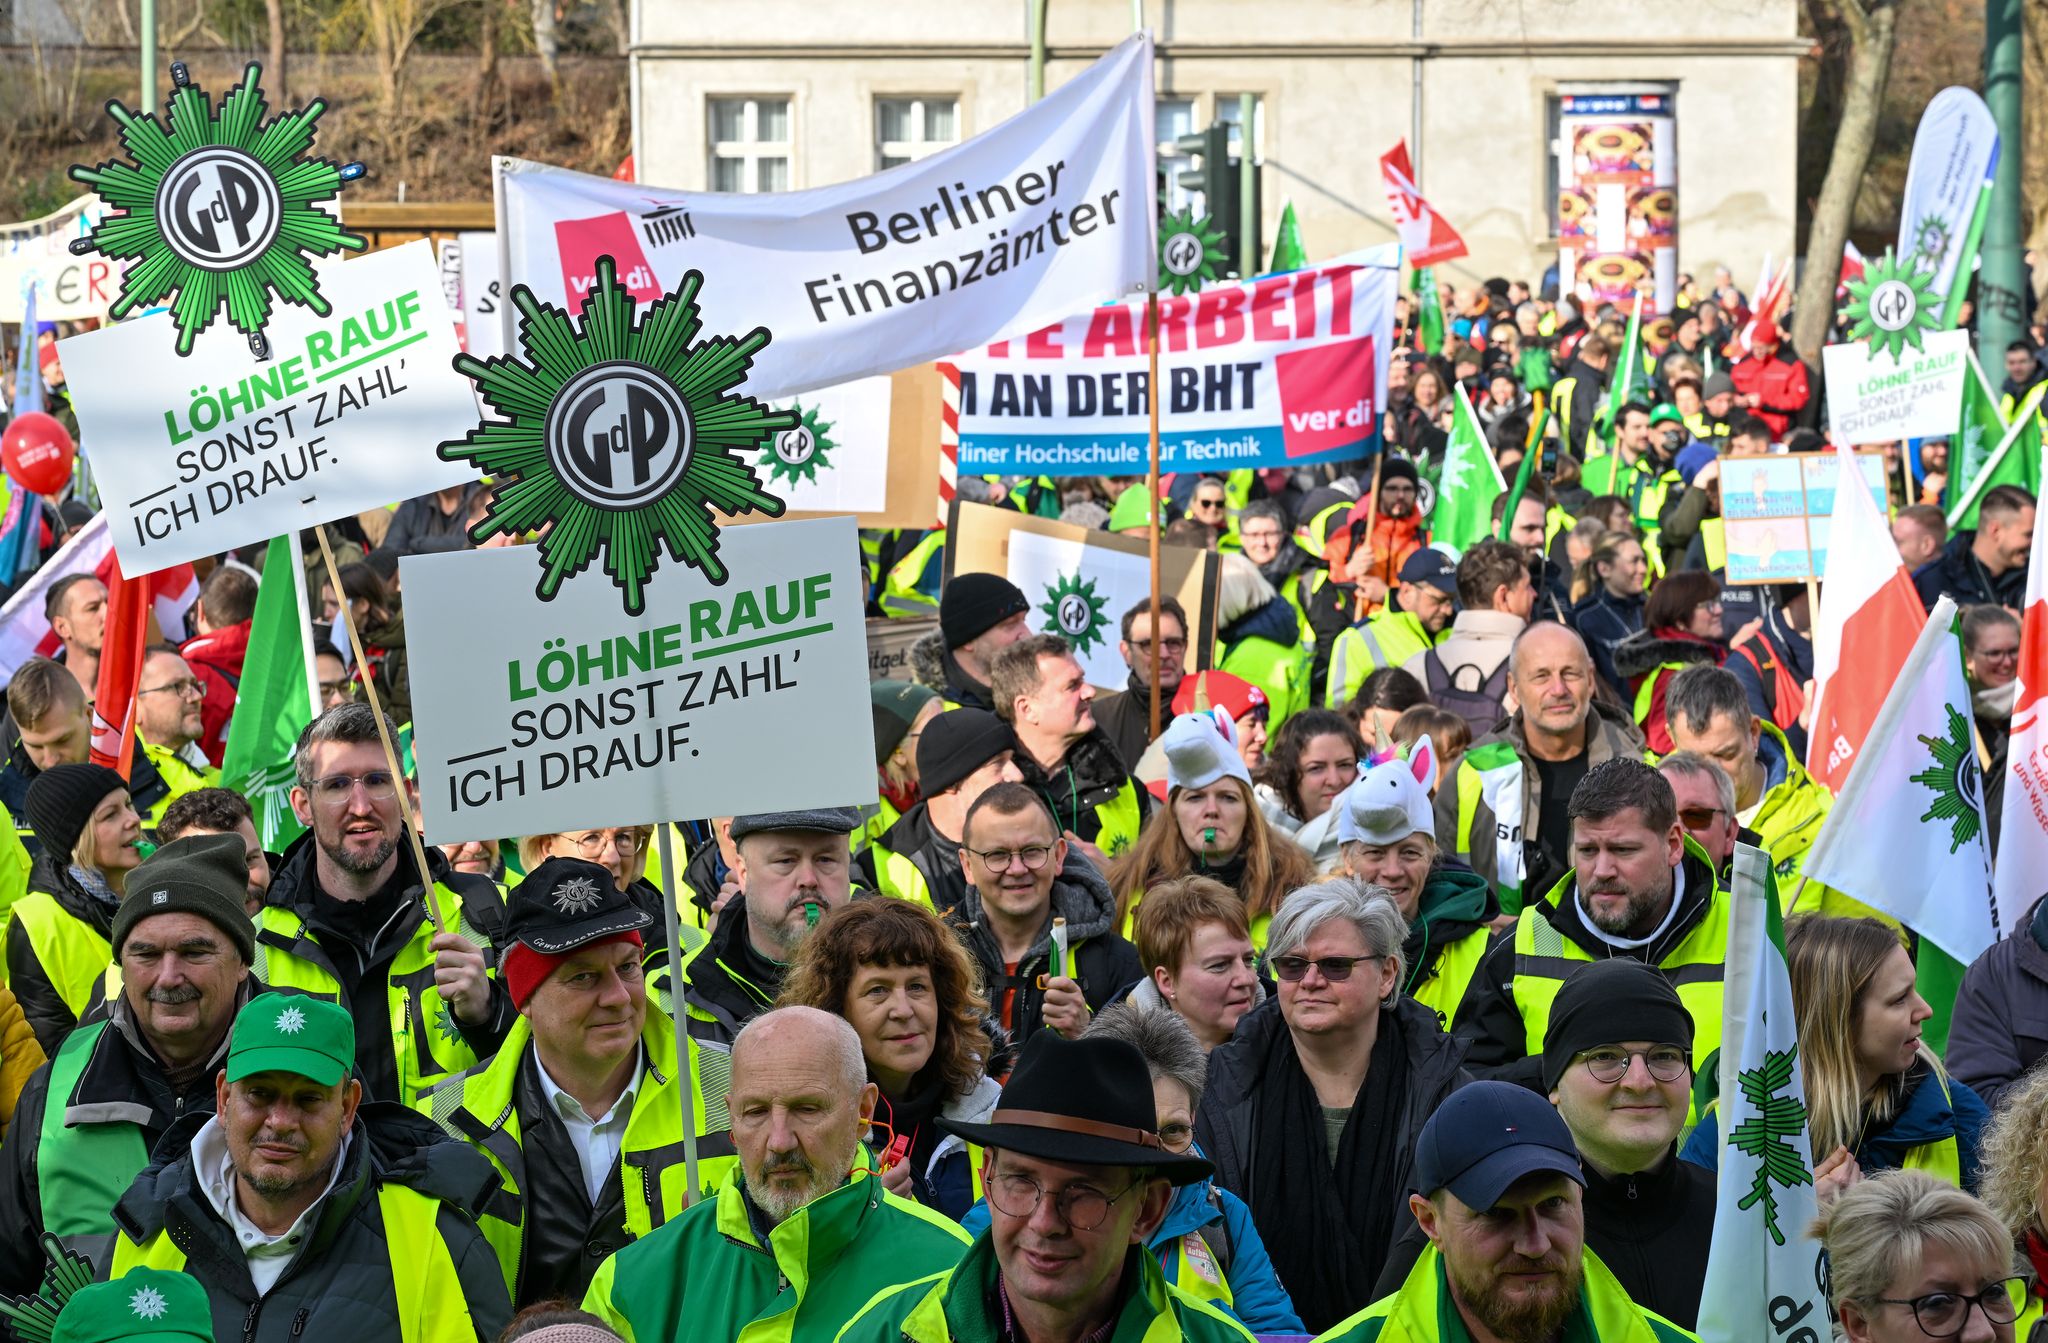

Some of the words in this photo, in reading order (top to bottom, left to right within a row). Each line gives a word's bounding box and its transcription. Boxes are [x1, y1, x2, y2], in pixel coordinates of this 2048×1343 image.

[174, 164, 260, 254] GdP
[846, 160, 1065, 255] Berliner
[804, 189, 1120, 322] Finanzämter
[1083, 265, 1366, 358] ARBEIT
[164, 356, 309, 446] LÖHNE
[305, 290, 424, 370] RAUF
[989, 373, 1053, 418] AN
[1068, 372, 1150, 418] DER
[1170, 362, 1262, 414] BHT
[176, 404, 298, 484] SONST
[566, 383, 670, 488] GdP
[1014, 439, 1140, 463] Hochschule
[1181, 435, 1262, 461] Technik
[1288, 400, 1371, 434] ver.di
[133, 492, 204, 547] ICH
[206, 436, 338, 516] DRAUF.
[508, 623, 684, 702] LÖHNE
[689, 573, 832, 644] RAUF
[511, 679, 664, 748] SONST
[449, 759, 526, 812] ICH
[540, 722, 700, 791] DRAUF.
[533, 925, 612, 950] Gewerkschaft
